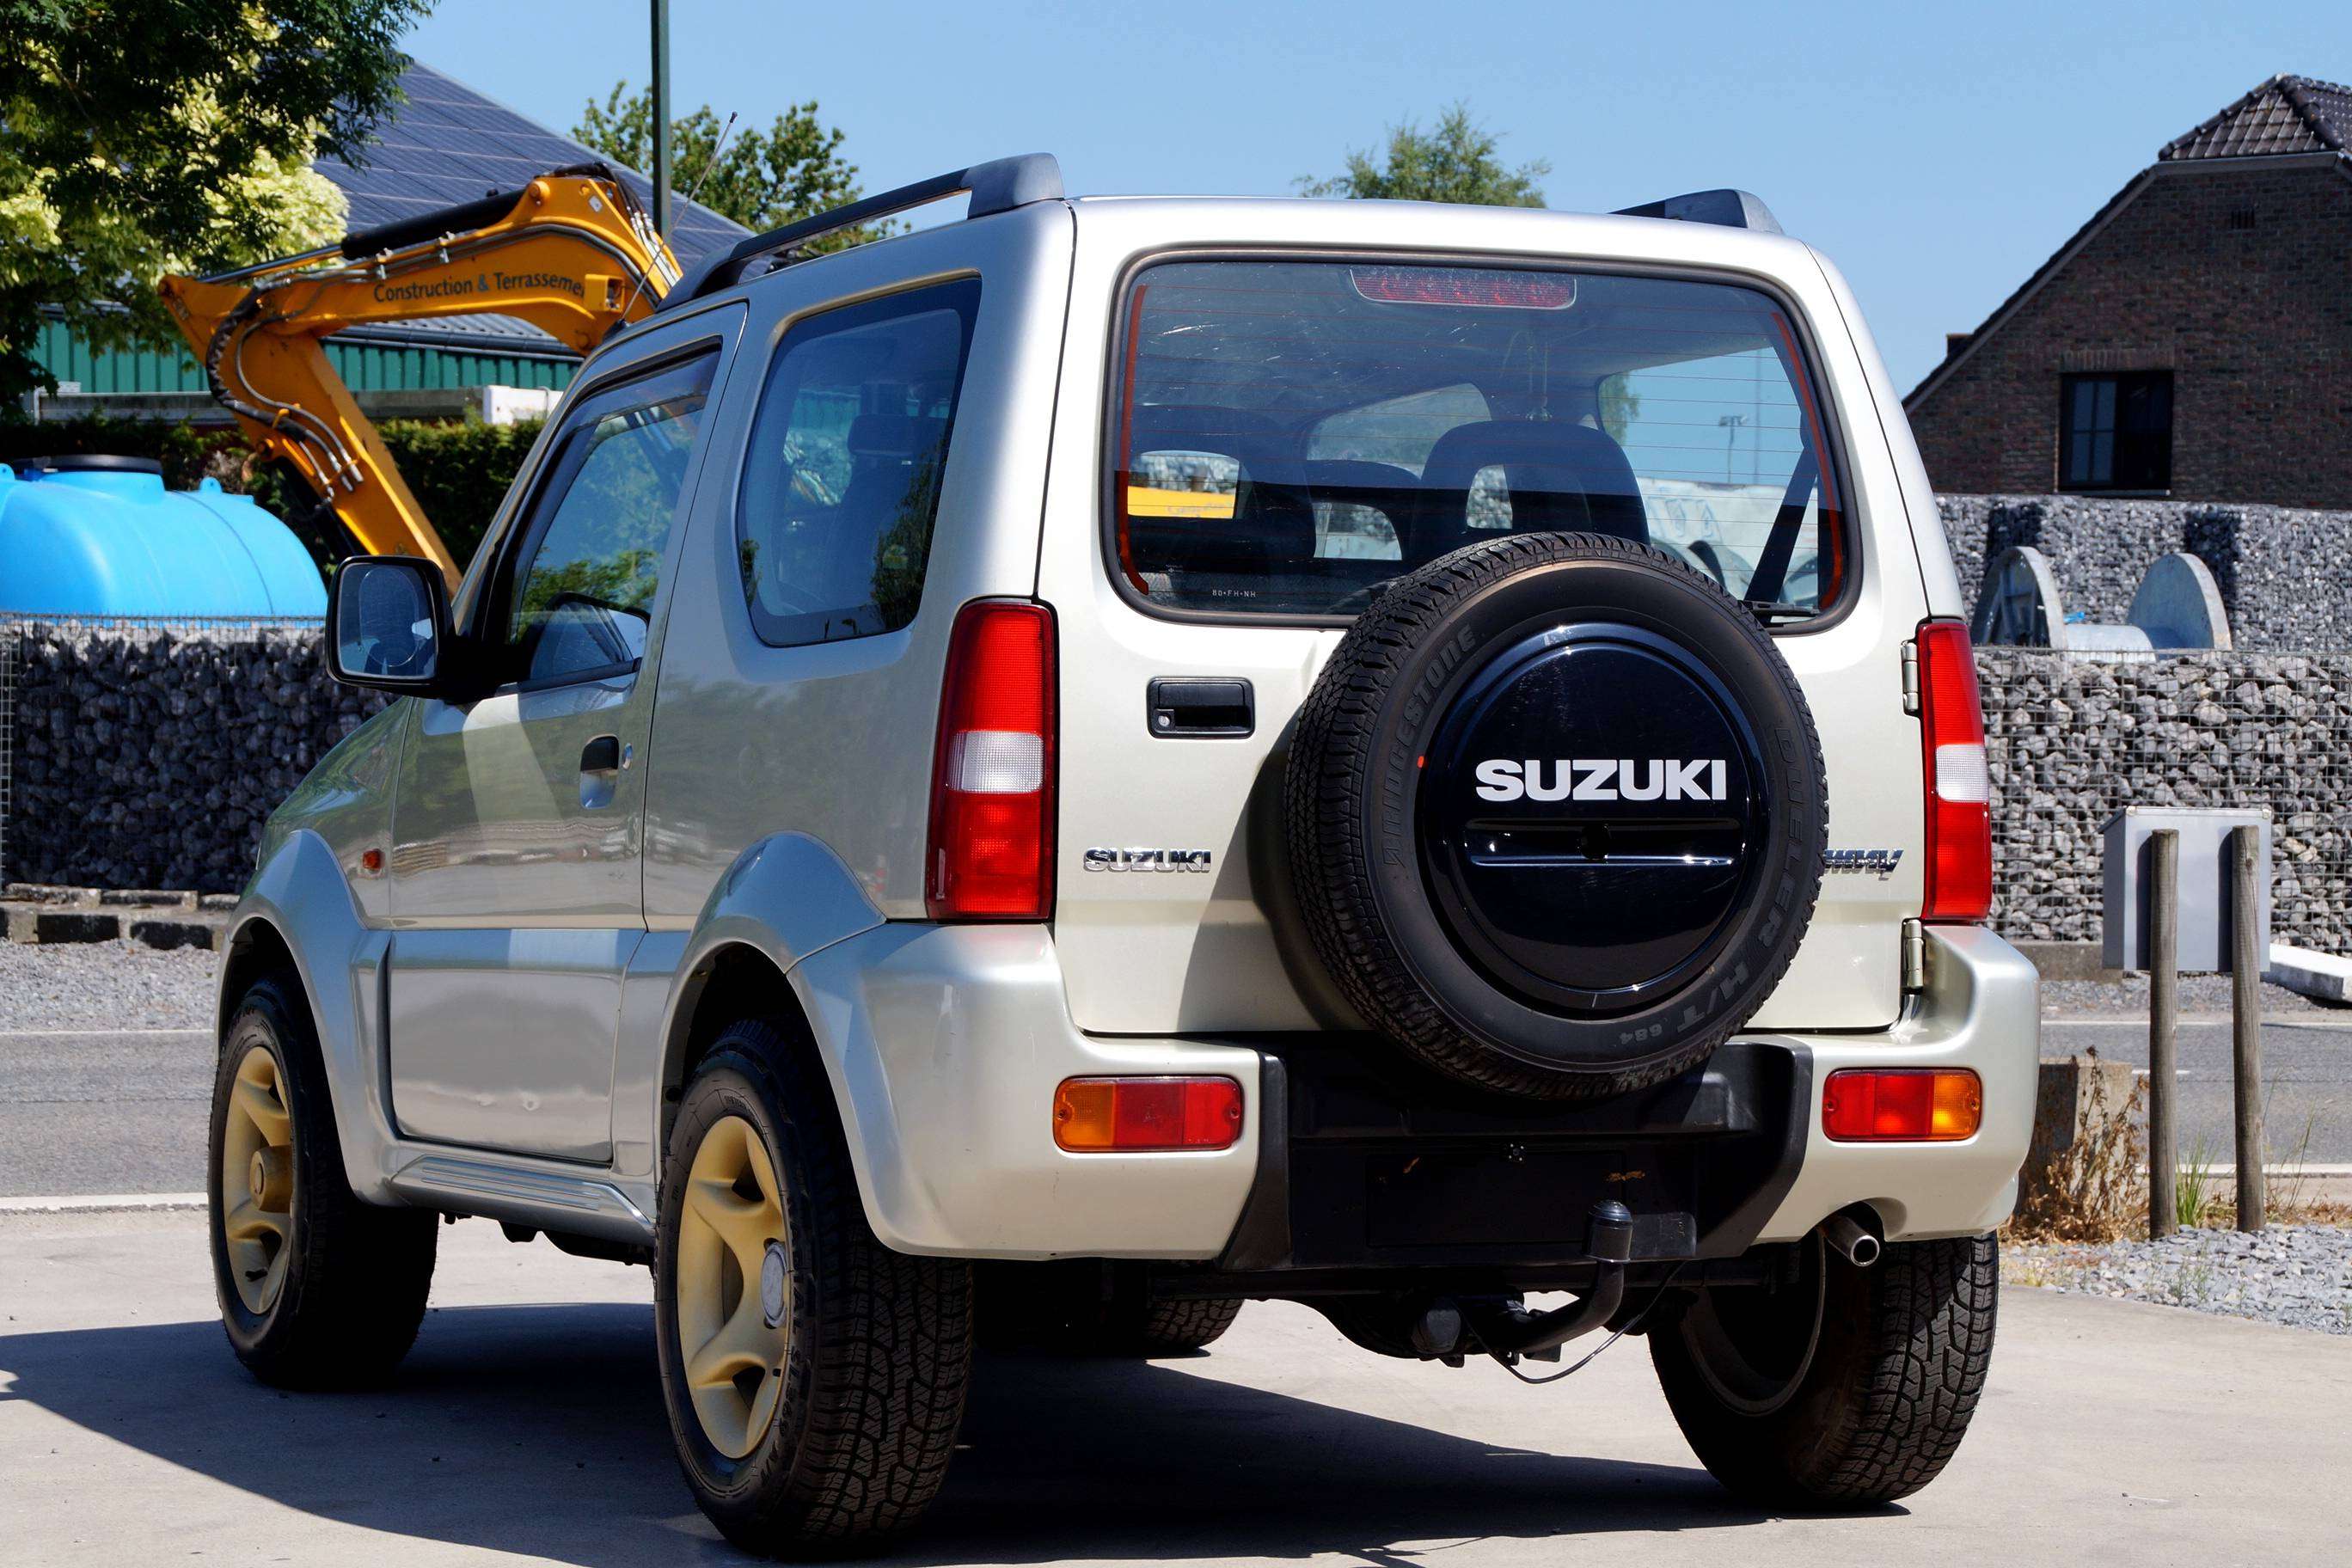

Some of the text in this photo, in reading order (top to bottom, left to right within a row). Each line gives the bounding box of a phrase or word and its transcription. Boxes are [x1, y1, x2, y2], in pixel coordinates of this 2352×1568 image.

[374, 277, 472, 302] Construction
[477, 274, 490, 291] &
[1475, 758, 1727, 802] SUZUKI
[1083, 847, 1211, 873] SUZUKI
[1619, 728, 1804, 1045] DUELER H/T 684
